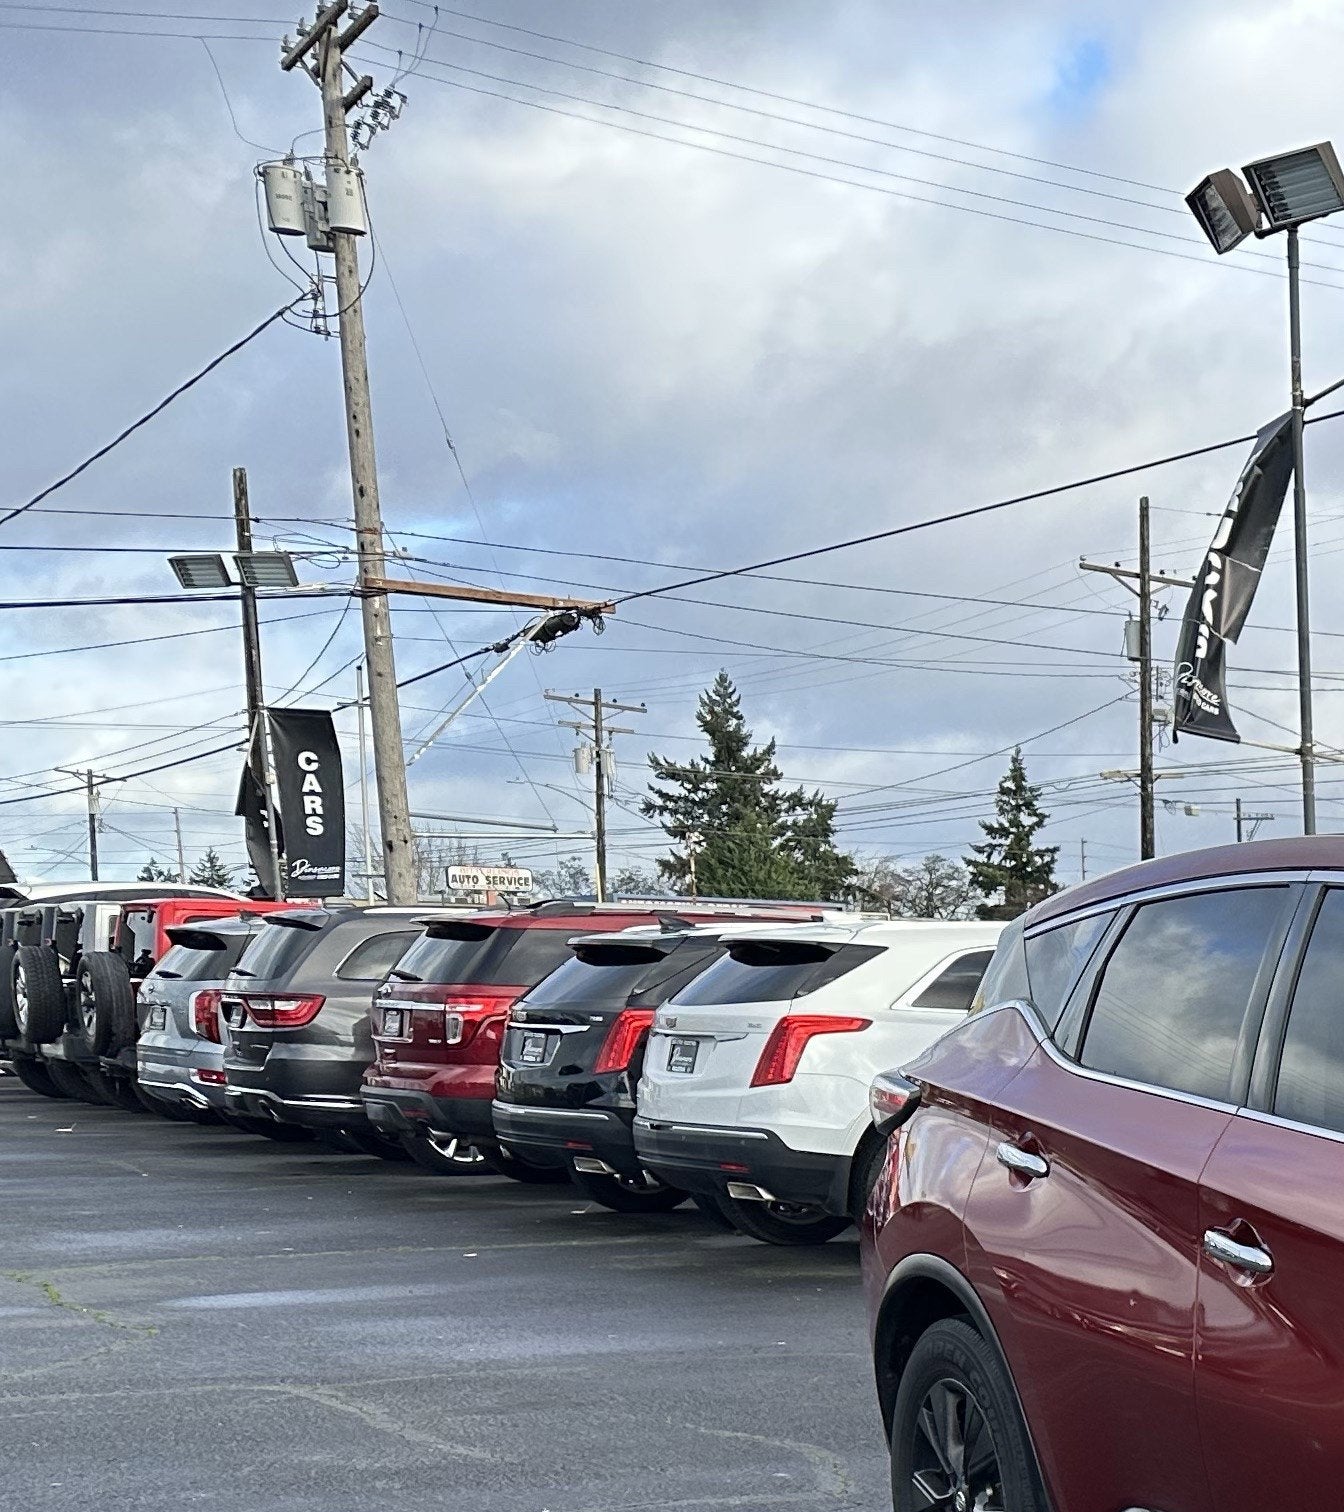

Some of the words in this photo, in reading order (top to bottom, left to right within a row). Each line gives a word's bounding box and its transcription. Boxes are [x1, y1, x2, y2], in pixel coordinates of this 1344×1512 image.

[297, 751, 324, 836] CARS
[451, 874, 480, 885] AUTO
[485, 875, 530, 887] SERVICE
